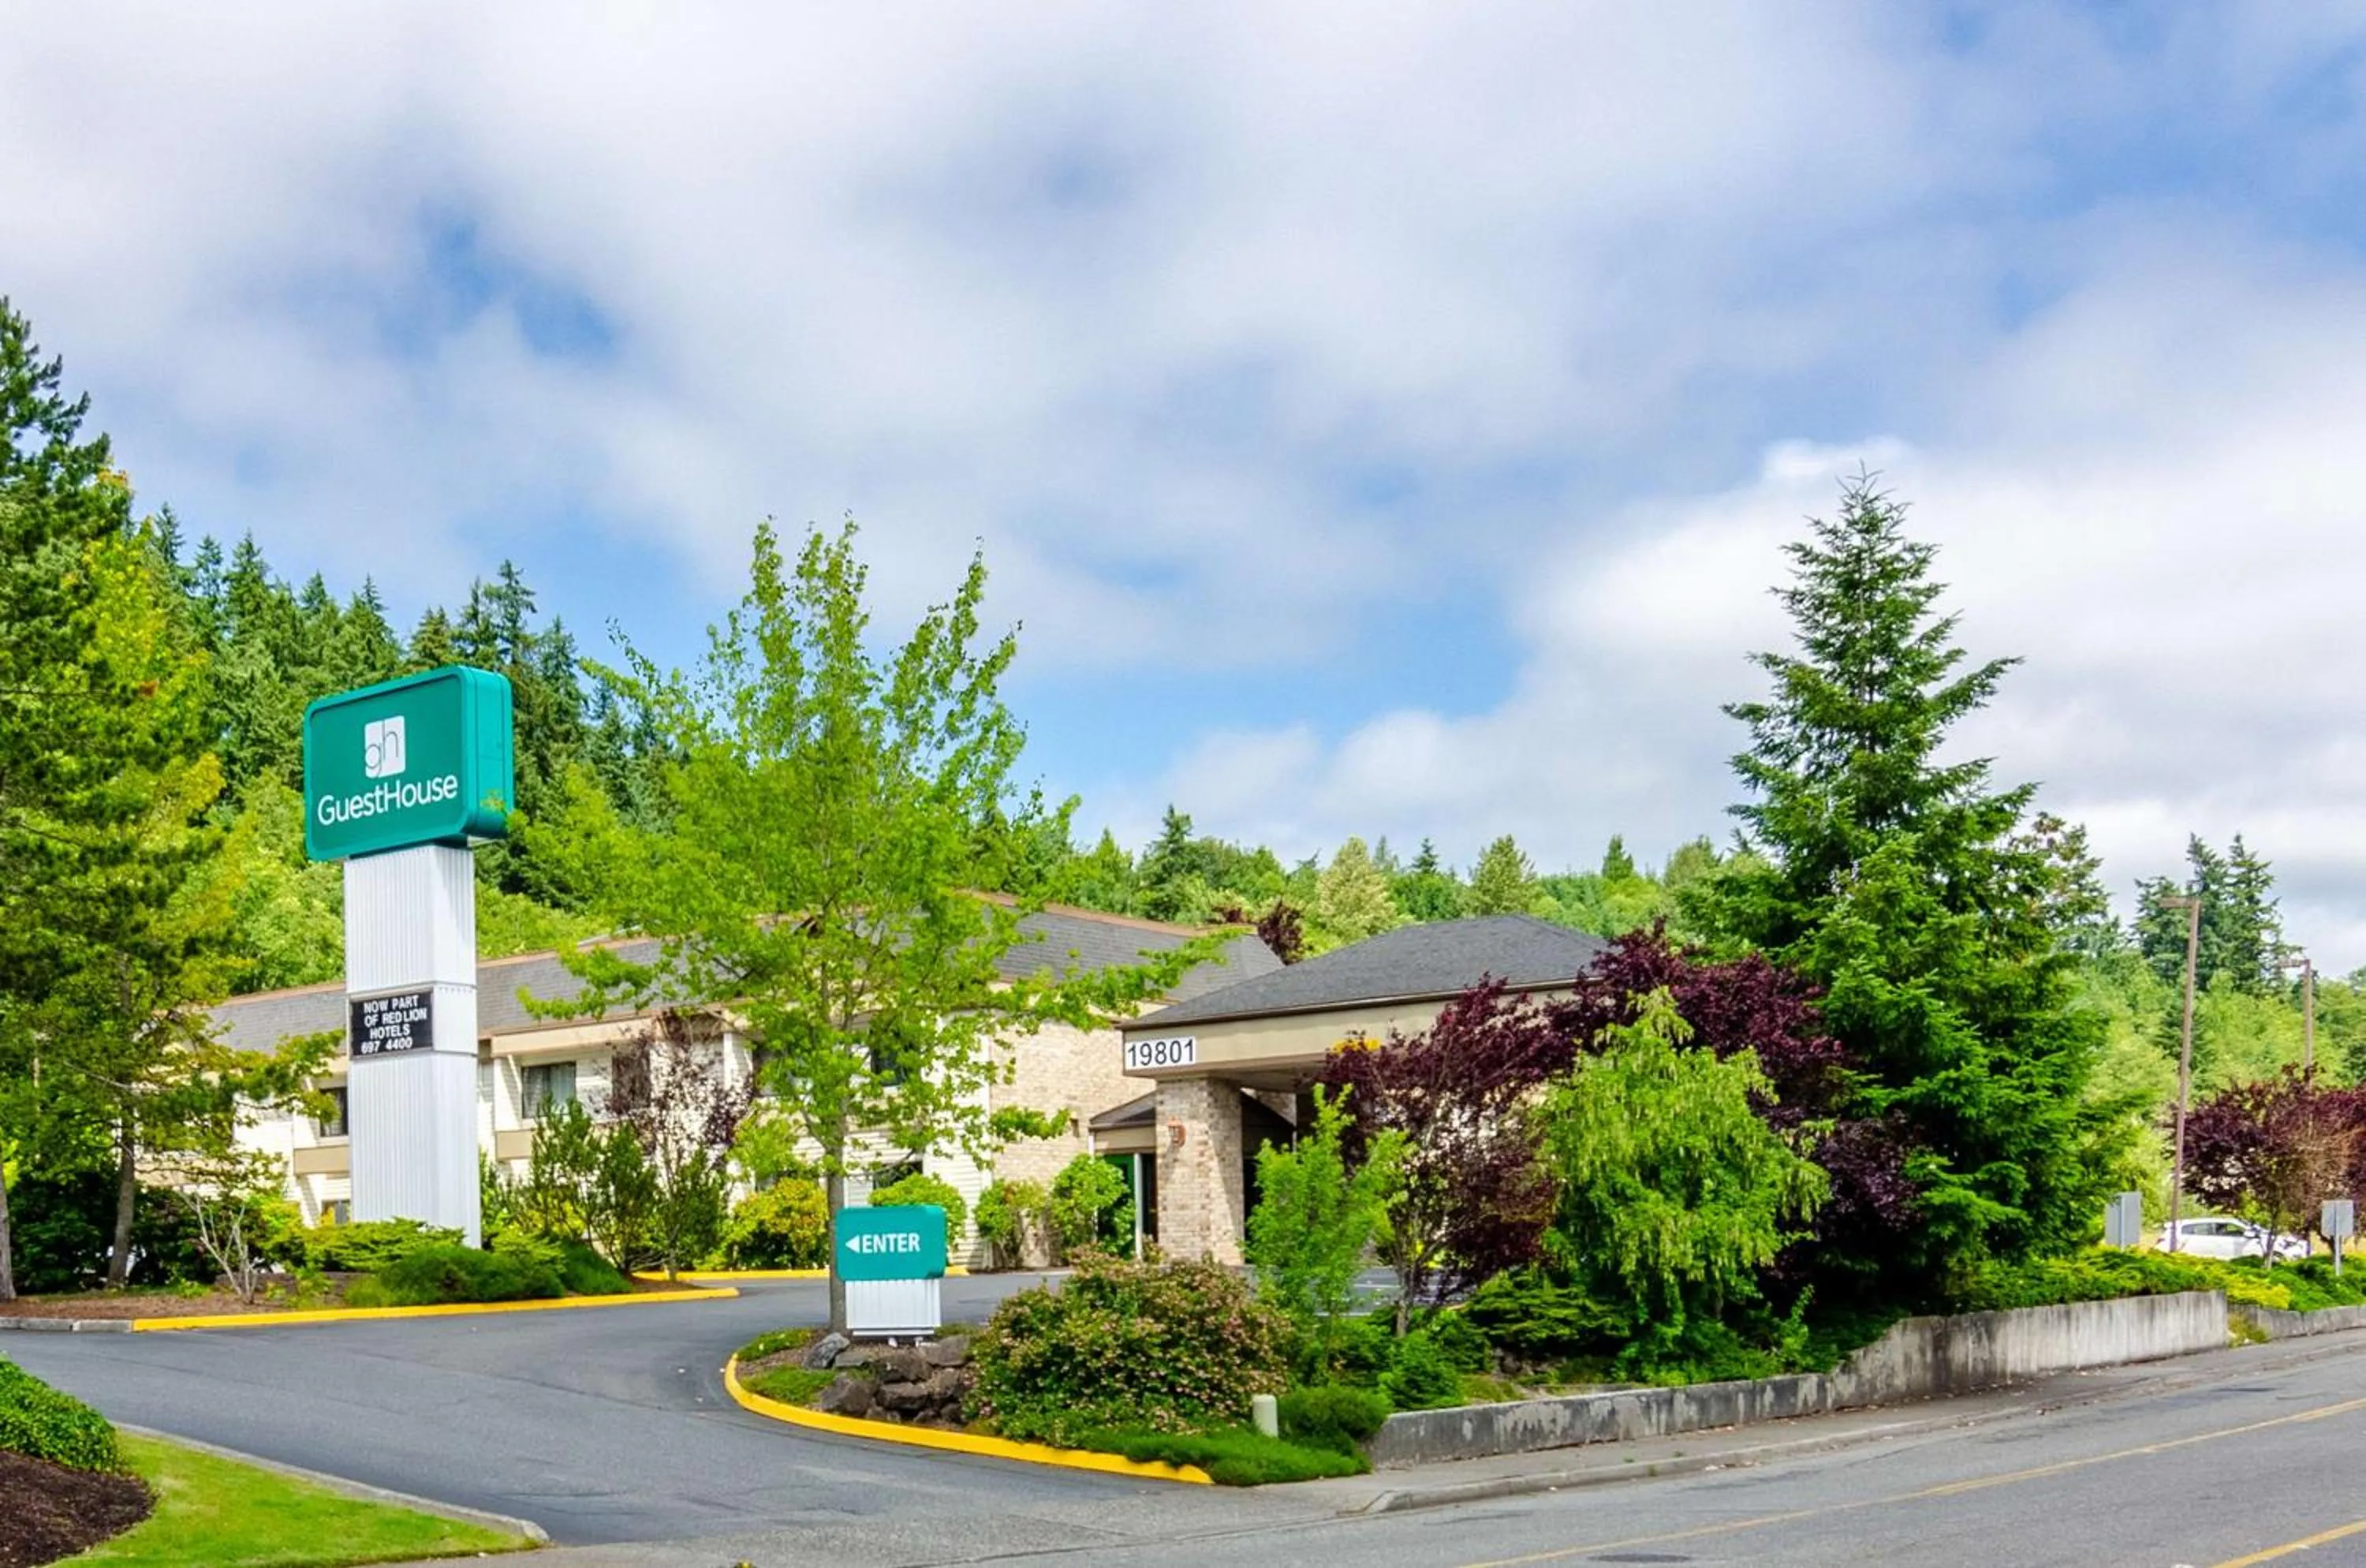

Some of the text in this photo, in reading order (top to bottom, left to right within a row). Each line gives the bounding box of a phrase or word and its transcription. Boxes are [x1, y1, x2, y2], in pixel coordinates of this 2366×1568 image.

[318, 775, 457, 825] GuestHouse
[364, 995, 419, 1014] NOW PART
[364, 1014, 379, 1027] OF
[370, 1024, 410, 1040] HOTELS
[361, 1036, 412, 1054] 697 4400
[1128, 1039, 1193, 1066] 19801
[862, 1233, 920, 1253] ENTER
